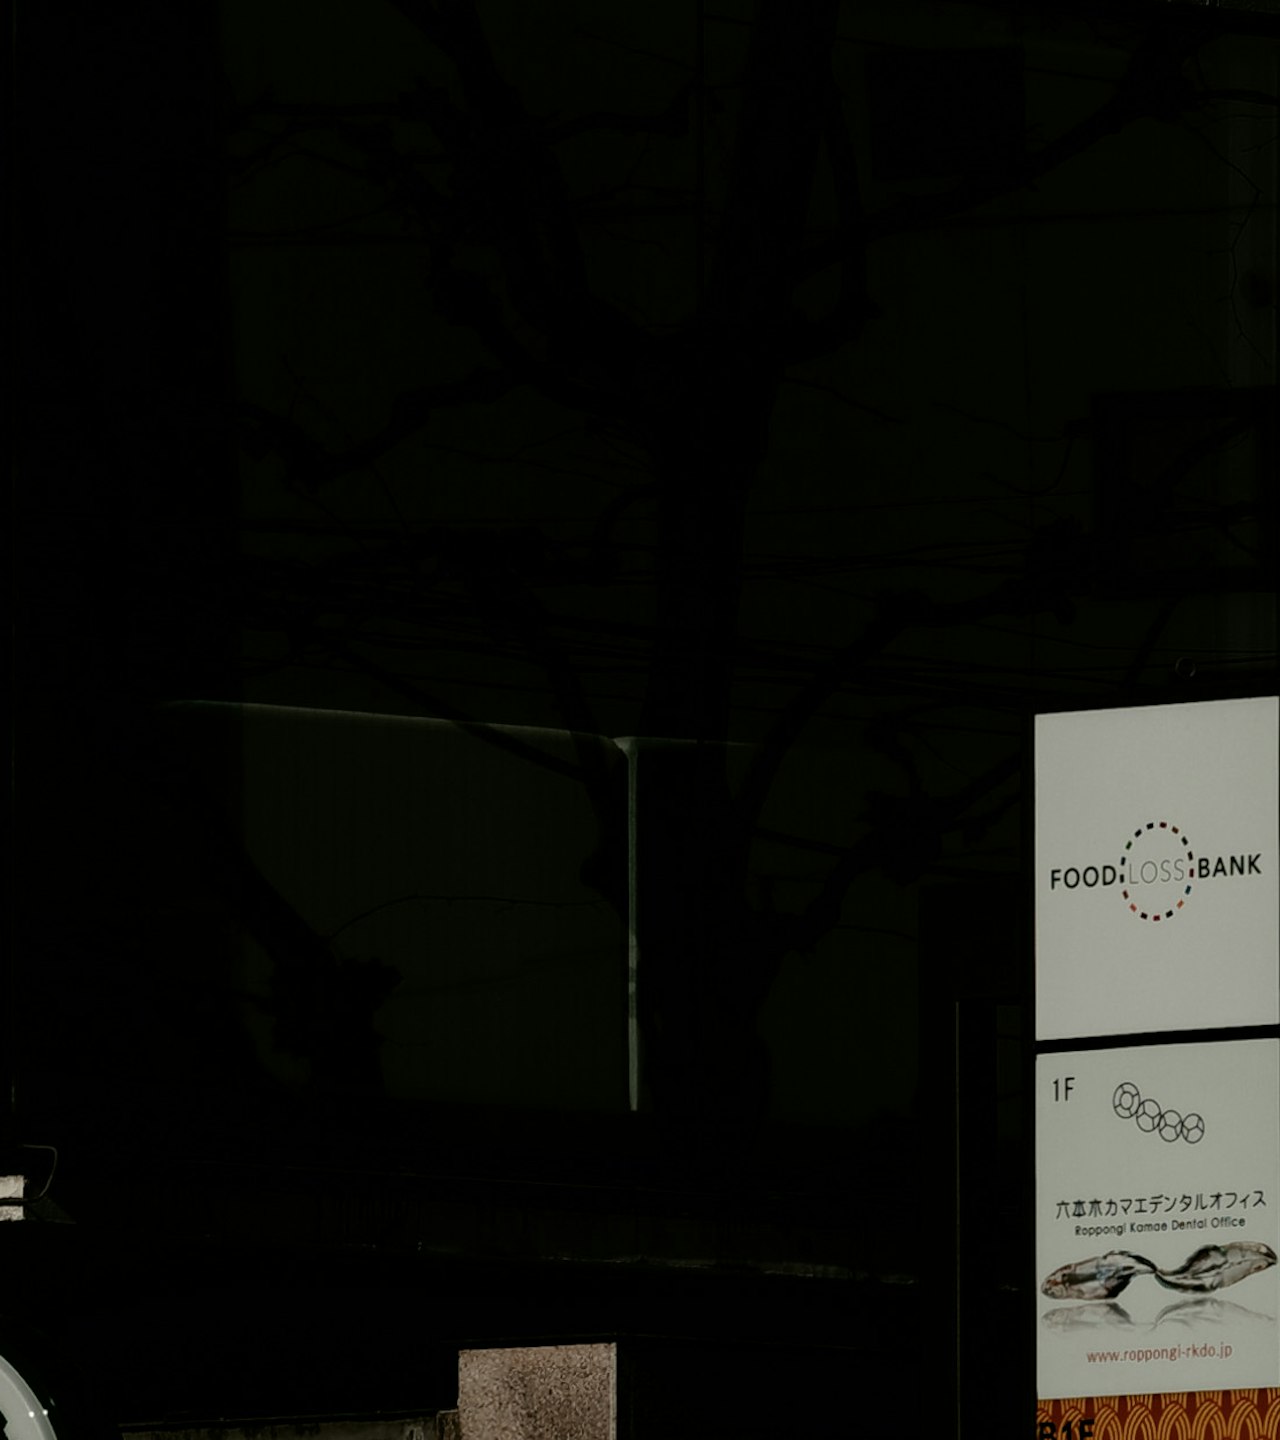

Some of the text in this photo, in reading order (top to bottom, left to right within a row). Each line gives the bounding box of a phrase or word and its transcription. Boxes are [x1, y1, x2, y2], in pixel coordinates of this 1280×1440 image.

[1051, 853, 1262, 890] FOOD LOSS BANK
[1052, 1077, 1075, 1102] 1F
[1055, 1190, 1267, 1220] 六本木カマエデンタルオフィス
[1075, 1216, 1246, 1237] Roppongi Kamae Dental Office
[1087, 1342, 1233, 1363] www.roppongi-rkdo.jp
